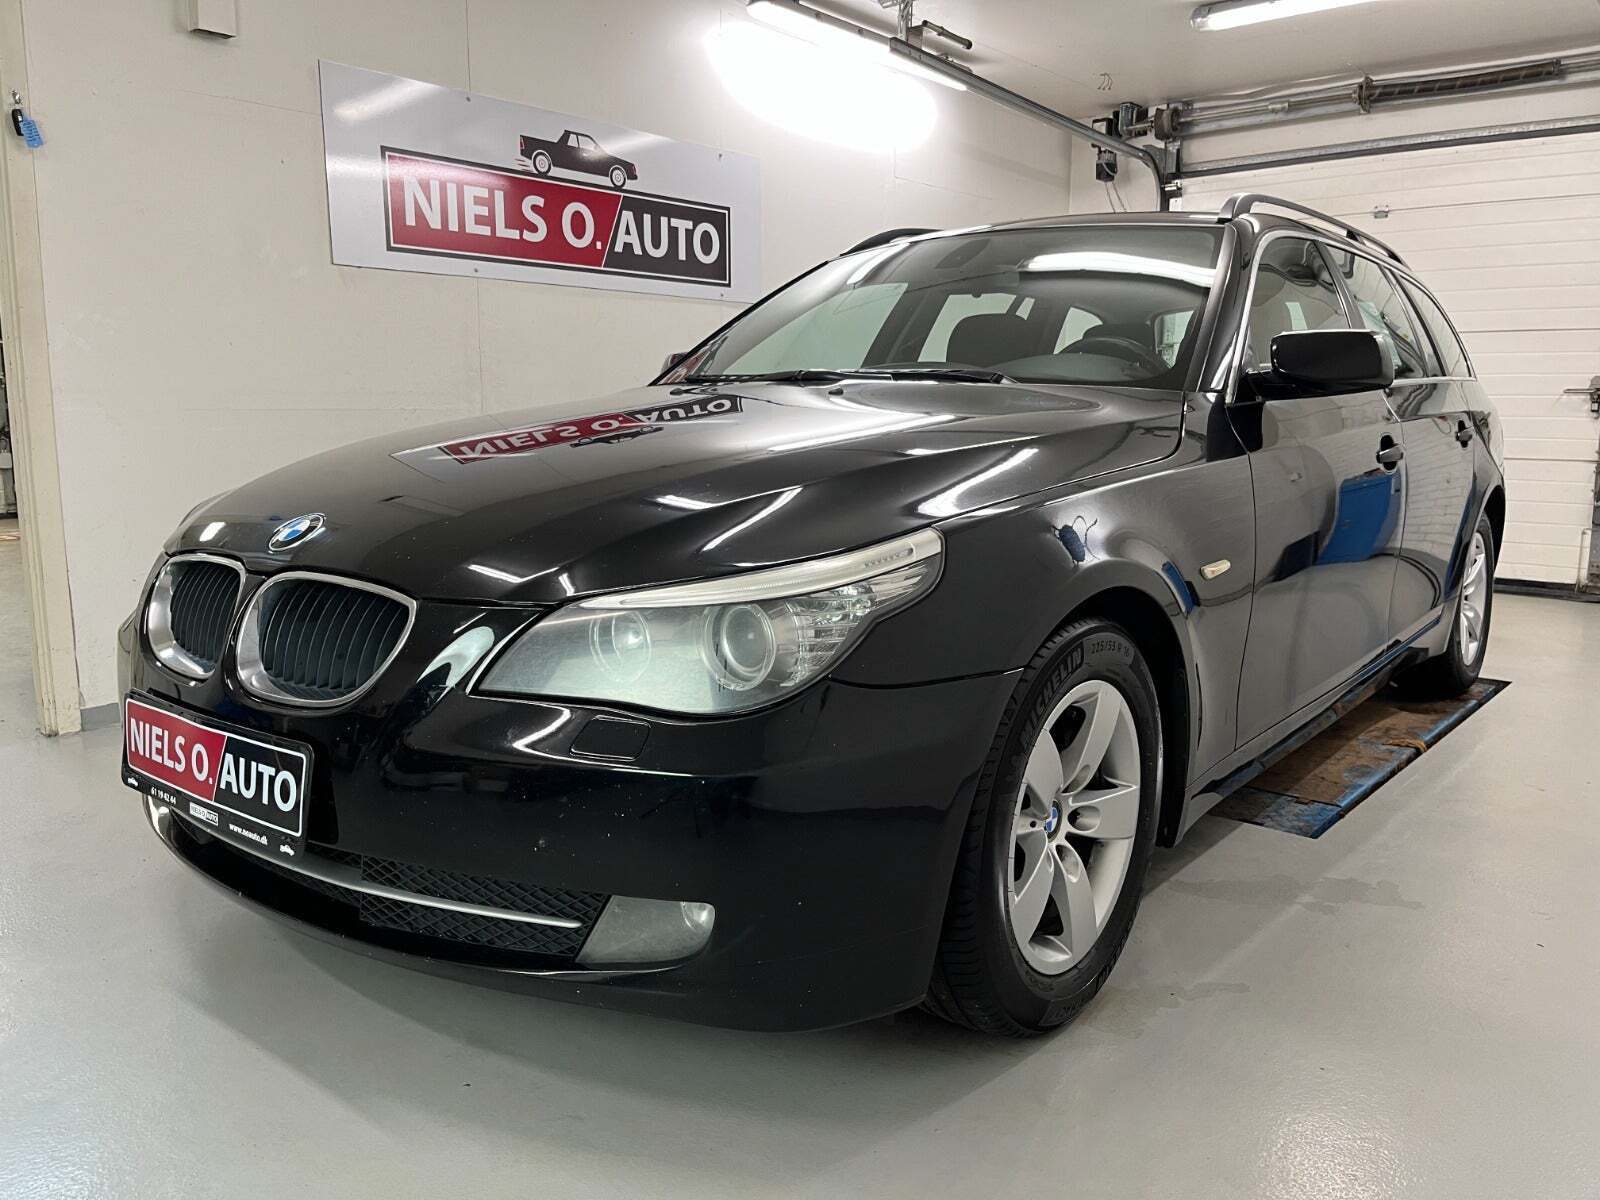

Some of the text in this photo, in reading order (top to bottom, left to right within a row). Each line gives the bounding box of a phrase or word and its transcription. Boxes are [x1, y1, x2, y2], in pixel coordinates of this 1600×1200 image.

[403, 177, 720, 264] NIELS O. AUTO
[129, 717, 297, 812] NIELS O. AUTO
